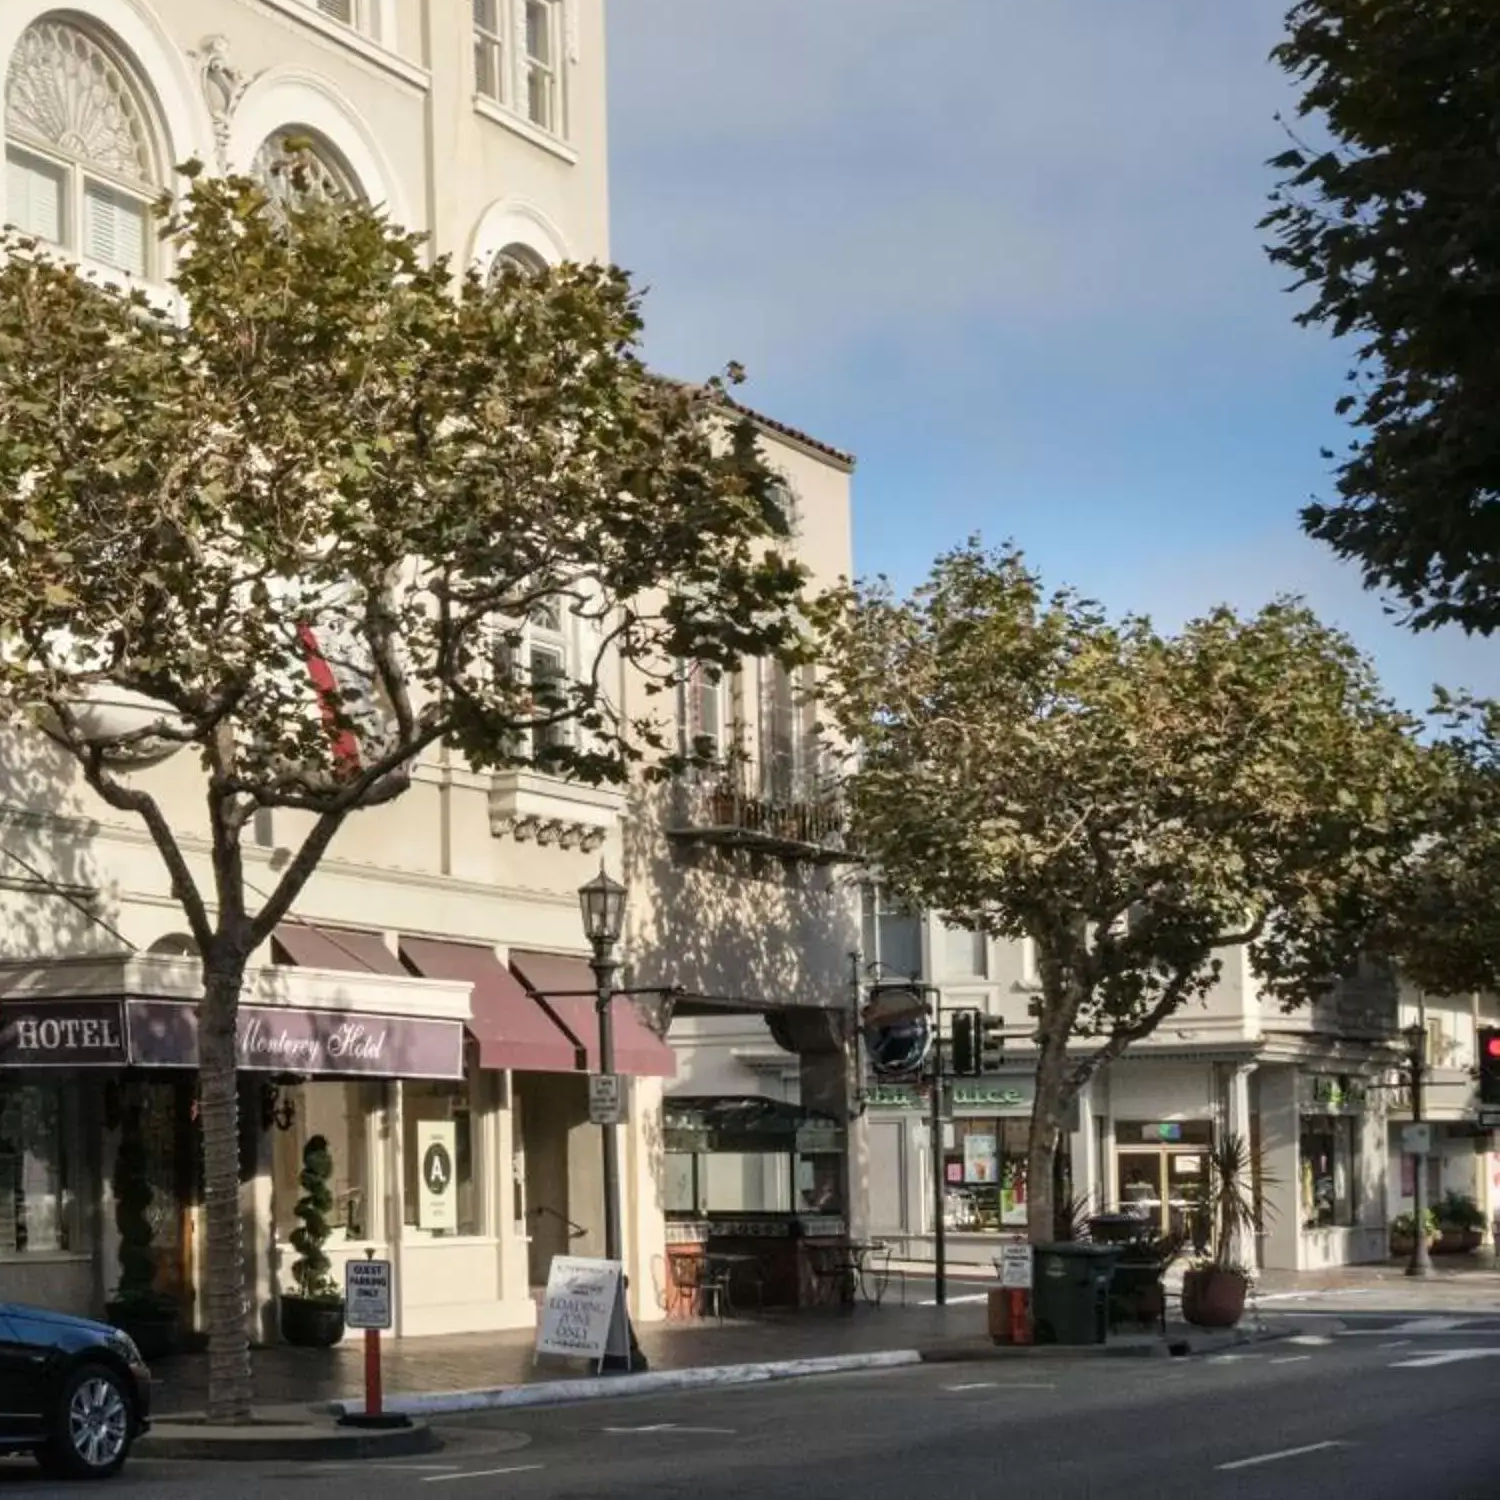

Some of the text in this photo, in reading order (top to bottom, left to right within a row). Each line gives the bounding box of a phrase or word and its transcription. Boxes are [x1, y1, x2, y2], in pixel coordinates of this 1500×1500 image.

[16, 1019, 121, 1049] HOTEL
[327, 1022, 386, 1059] Hotel
[349, 1276, 386, 1287] PARKING
